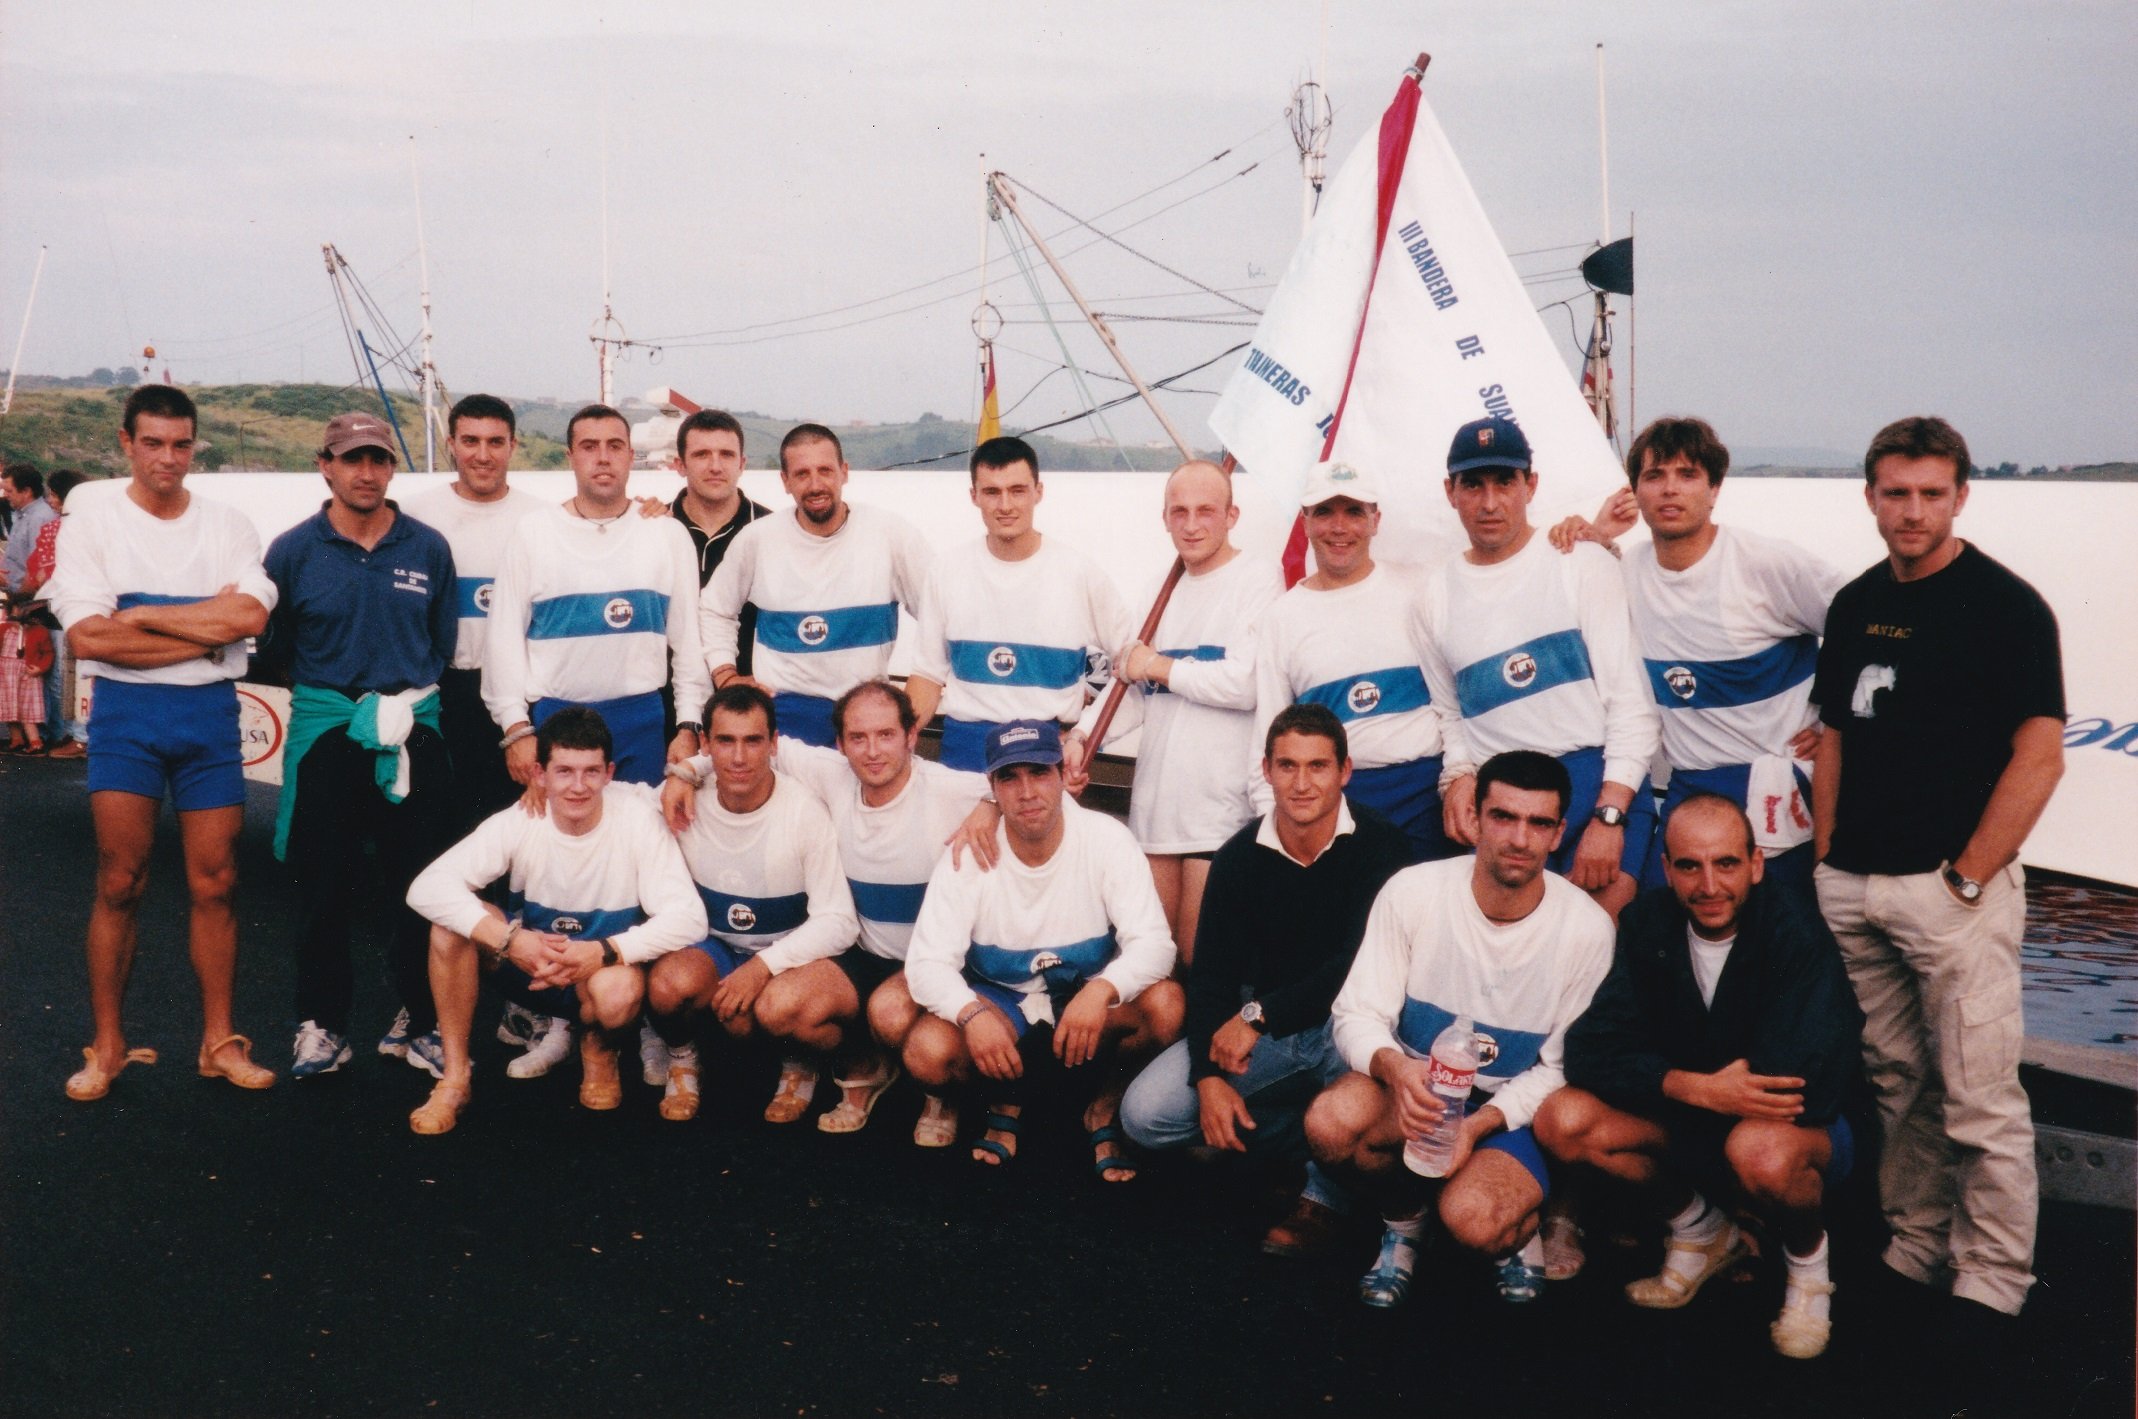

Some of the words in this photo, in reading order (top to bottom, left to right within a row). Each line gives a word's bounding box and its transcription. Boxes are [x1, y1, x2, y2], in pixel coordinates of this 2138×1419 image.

[1398, 220, 1424, 243] III
[1407, 237, 1459, 311] BANDERA
[1456, 334, 1485, 361] DE
[1479, 383, 1520, 427] SUA
